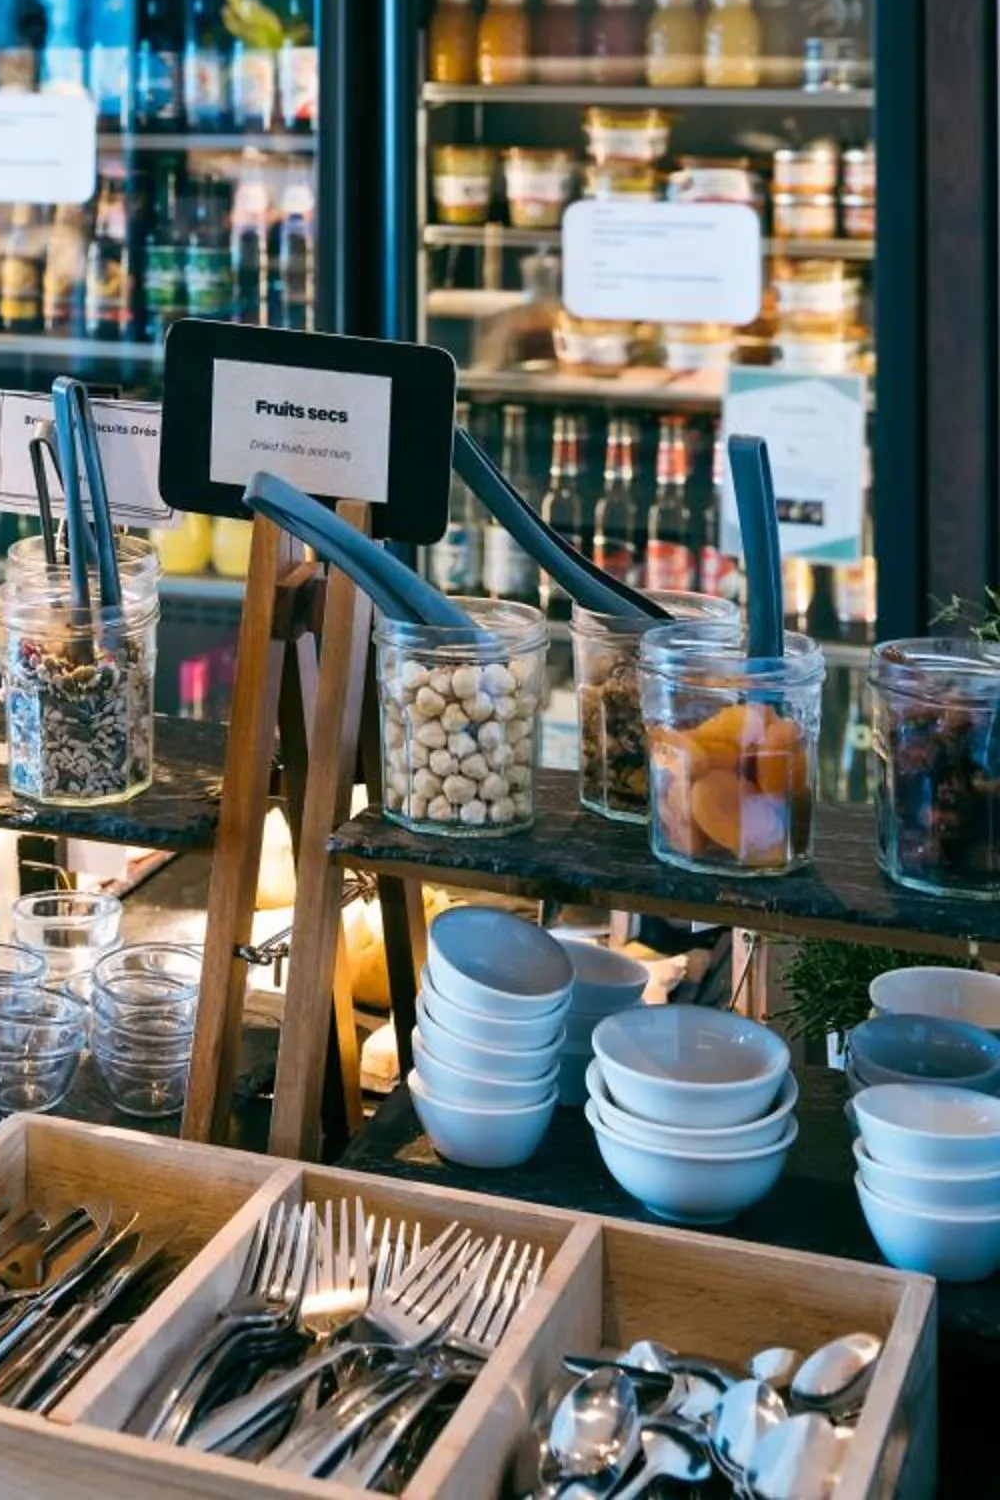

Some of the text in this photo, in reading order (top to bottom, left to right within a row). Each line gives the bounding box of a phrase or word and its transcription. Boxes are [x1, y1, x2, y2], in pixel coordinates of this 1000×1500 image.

[255, 399, 349, 423] Fruits secs
[307, 447, 329, 457] and
